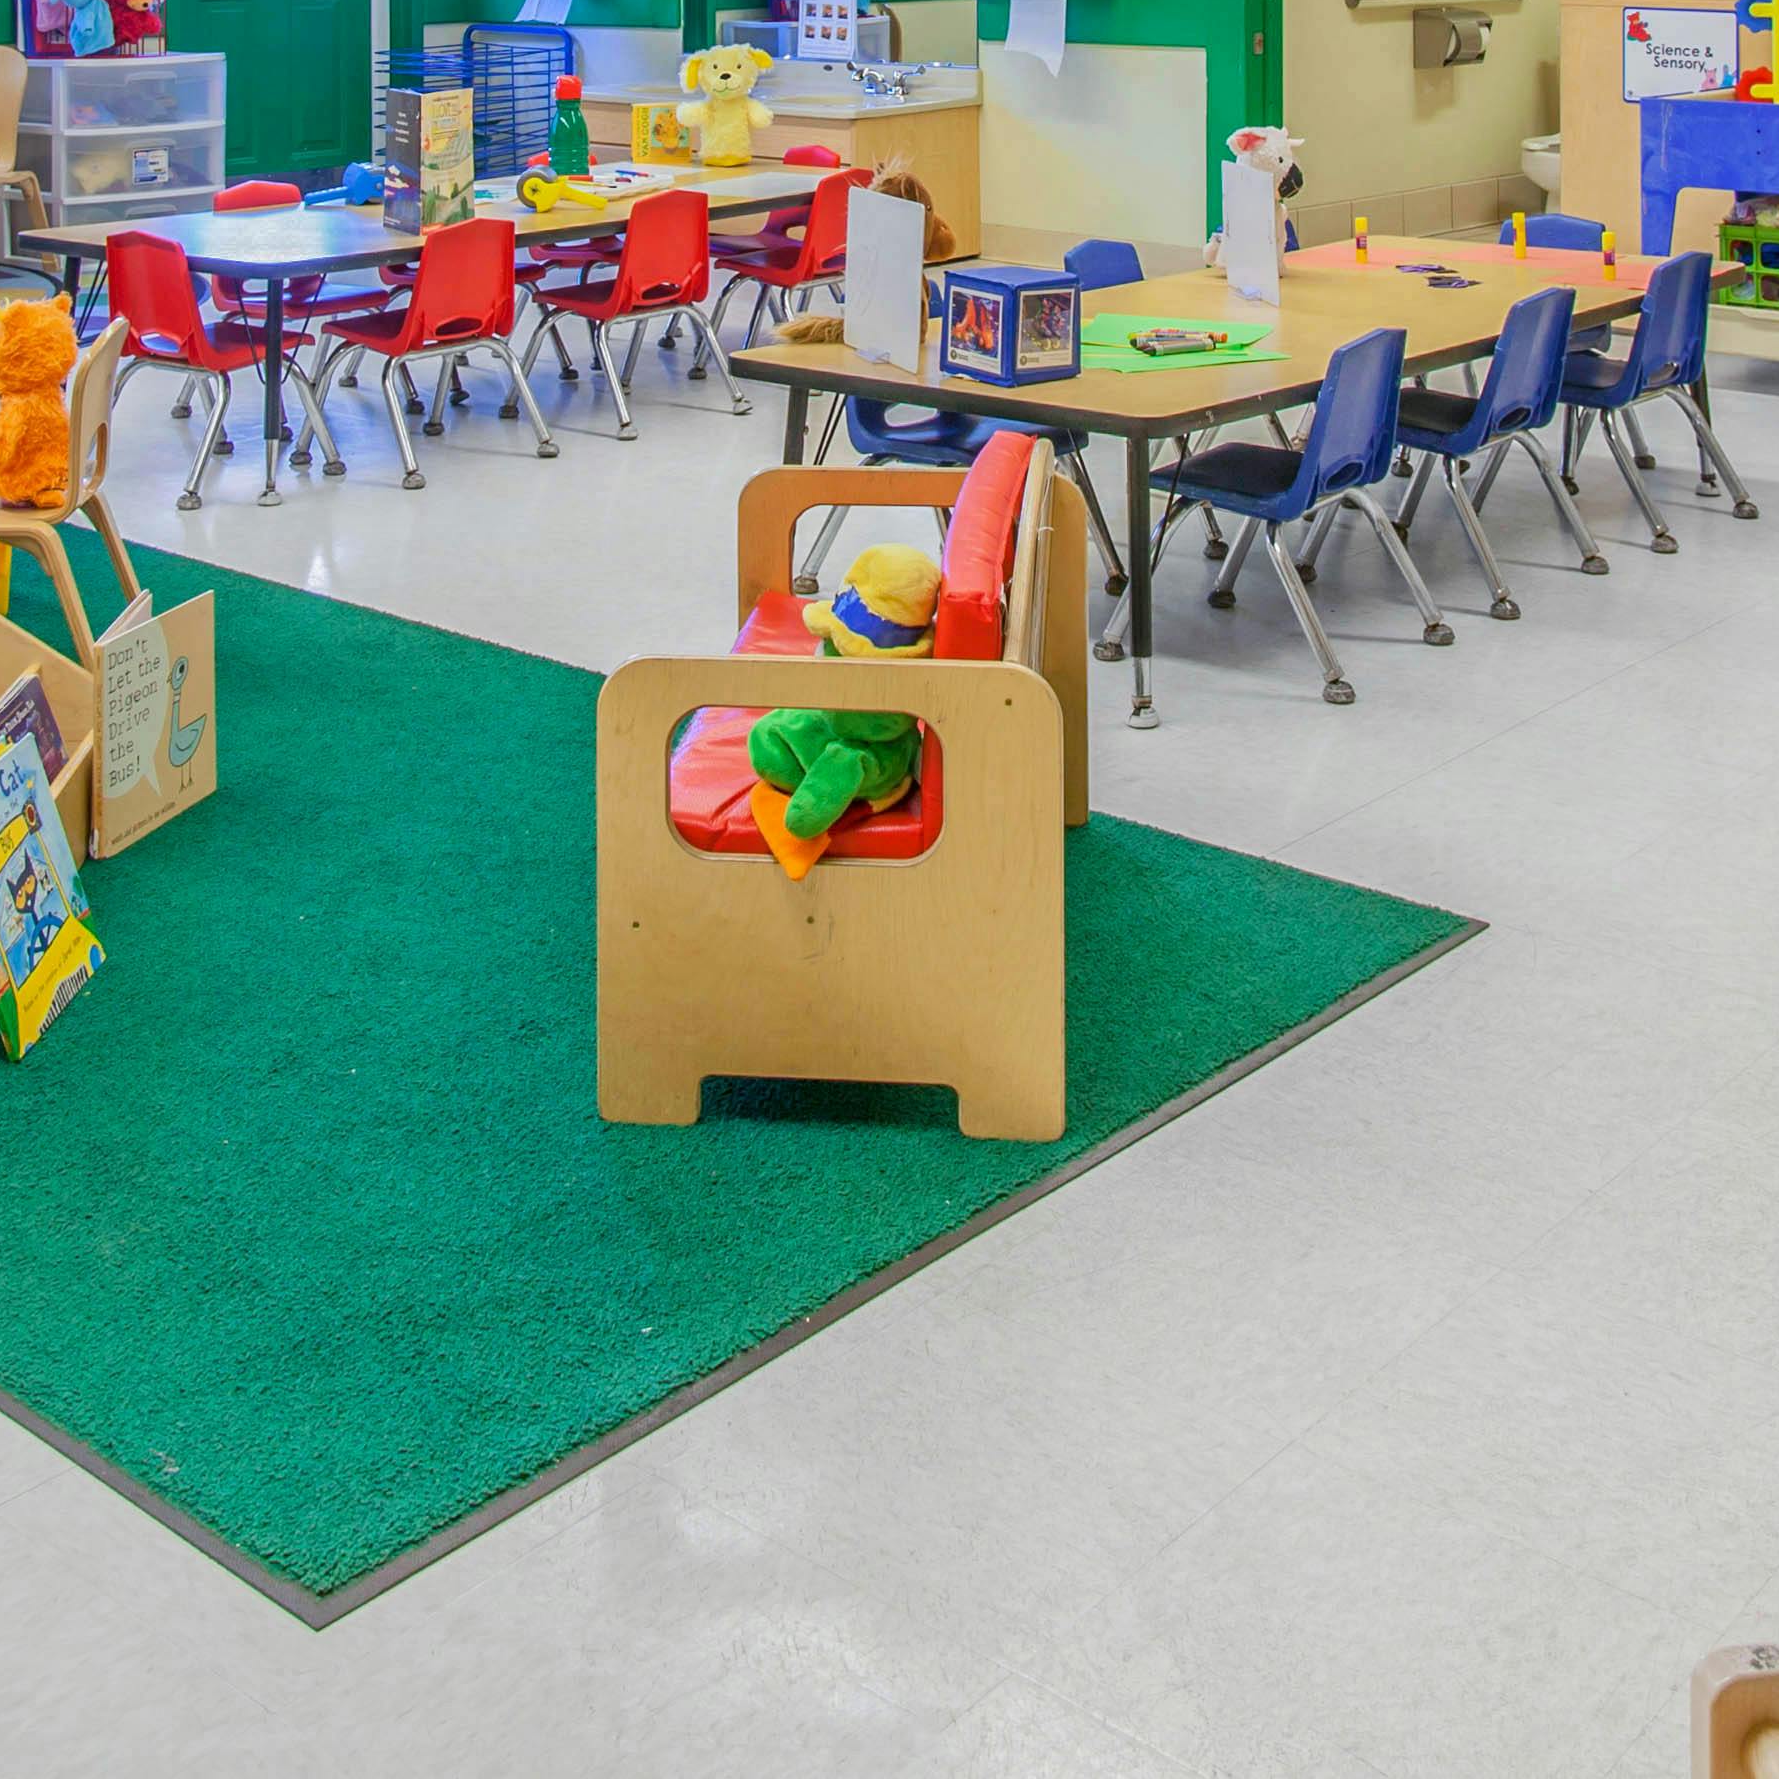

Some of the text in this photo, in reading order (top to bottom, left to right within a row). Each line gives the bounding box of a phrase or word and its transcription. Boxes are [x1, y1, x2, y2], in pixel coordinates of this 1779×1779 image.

[1646, 43, 1713, 57] Science &
[1653, 56, 1706, 73] Sensory
[108, 638, 148, 670] Don't
[108, 654, 161, 695] Let the
[108, 680, 158, 717] Pigeon
[108, 707, 150, 741] Drive
[109, 739, 134, 762] the
[109, 755, 141, 788] Bus!
